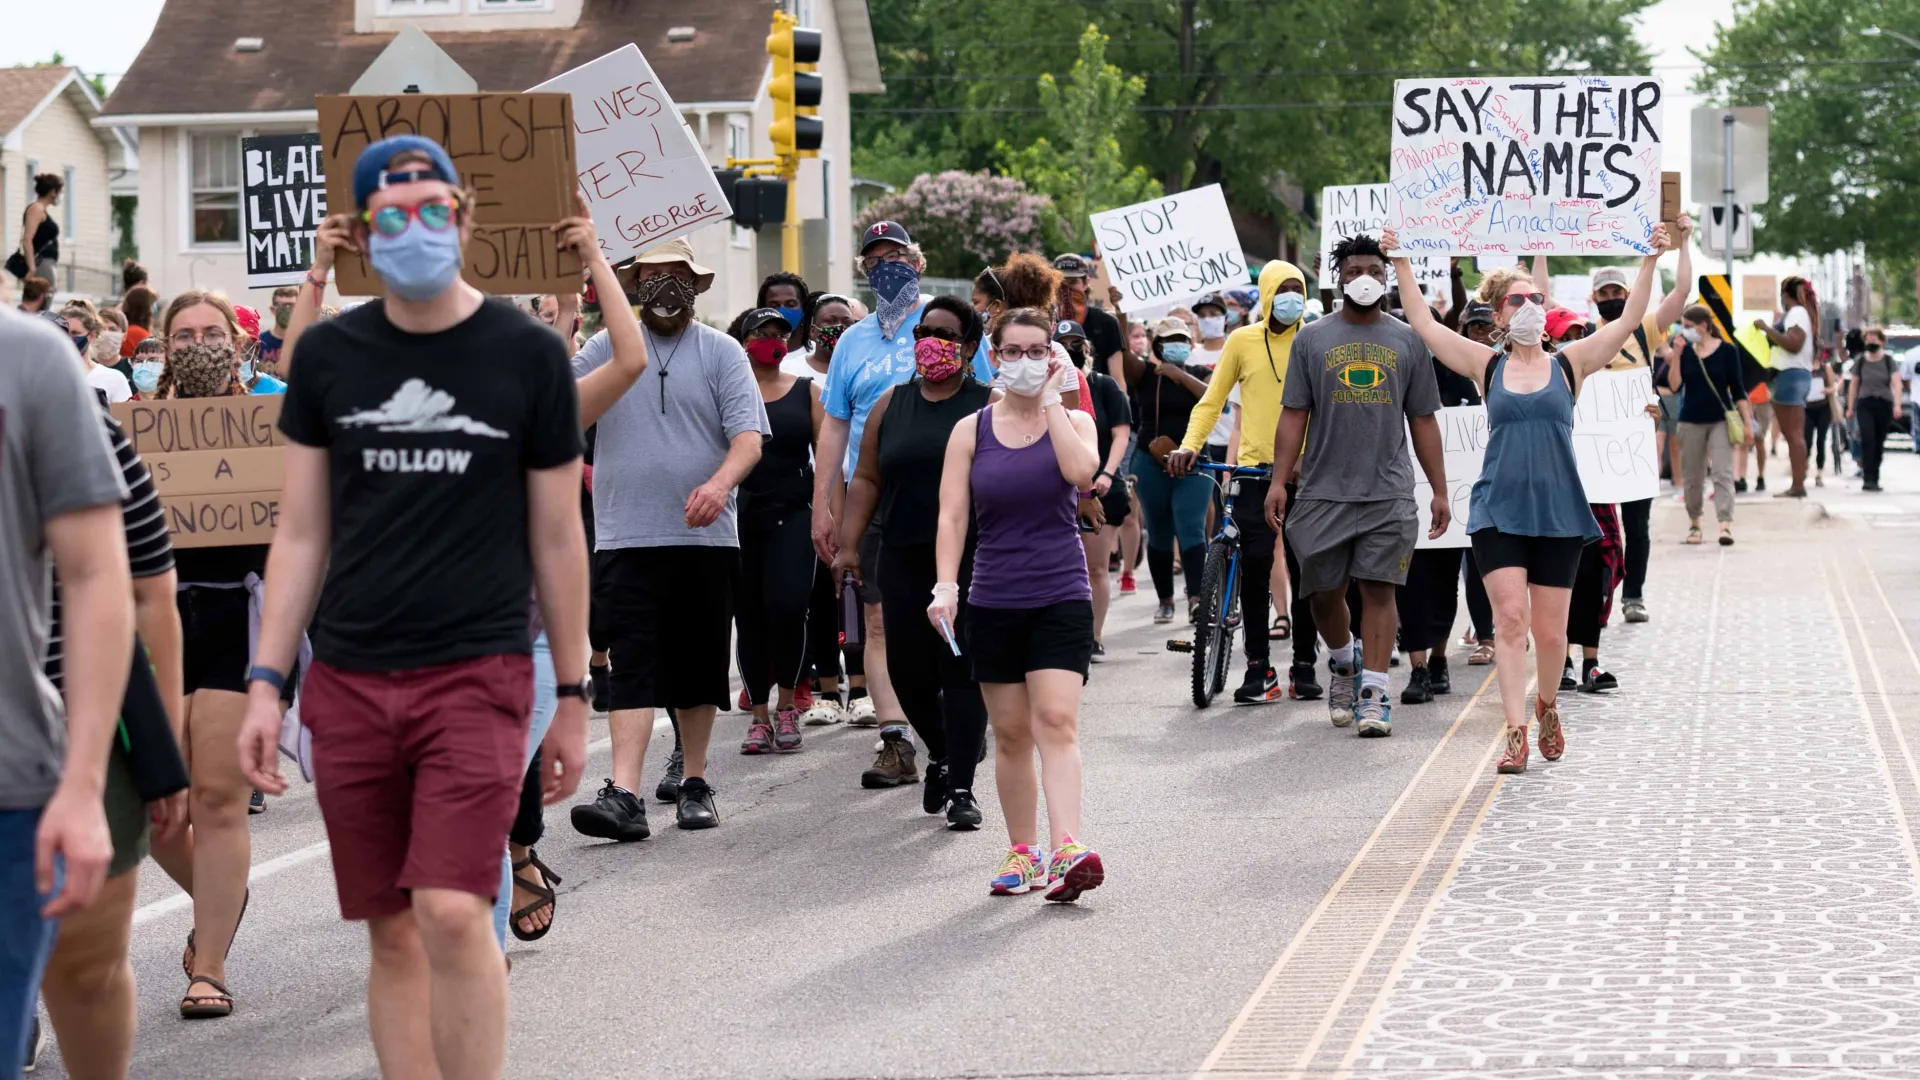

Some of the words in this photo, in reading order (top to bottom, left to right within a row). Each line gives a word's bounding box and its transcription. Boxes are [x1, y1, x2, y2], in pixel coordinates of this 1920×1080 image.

[1577, 76, 1609, 87] Yvette
[332, 94, 570, 162] ABOLISH
[573, 81, 662, 135] LIVES
[1396, 85, 1493, 137] SAY
[1508, 81, 1661, 143] THEIR
[1481, 108, 1512, 141] Tamir
[1491, 94, 1529, 147] Sandra
[246, 144, 326, 187] BLAC
[578, 122, 674, 203] TER!
[1392, 134, 1459, 173] Philando
[1390, 160, 1463, 201] Freddie
[1462, 140, 1641, 208] NAMES
[250, 188, 328, 230] LIVE
[615, 193, 719, 242] GEORGE
[1390, 199, 1463, 231] Jamar
[1443, 198, 1480, 215] Carlos
[1487, 200, 1583, 235] Amadou
[1505, 188, 1533, 209] Andy
[1100, 200, 1178, 251] STOP
[1586, 211, 1624, 232] Eric
[1633, 198, 1655, 243] Victo
[250, 230, 318, 270] MATT
[472, 226, 583, 281] STATE
[1111, 237, 1204, 280] KILLING
[1520, 235, 1555, 251] John
[1560, 232, 1613, 253] Tyree
[1130, 270, 1180, 301] OUR
[1183, 249, 1242, 292] SONS
[1324, 342, 1363, 371] MESABI
[1364, 342, 1397, 371] RANGE
[1332, 389, 1393, 405] FOOTBALL
[132, 405, 274, 453] POLICING
[214, 457, 234, 480] A
[361, 448, 473, 475] FOLLOW
[167, 500, 280, 534] NOCIDE
